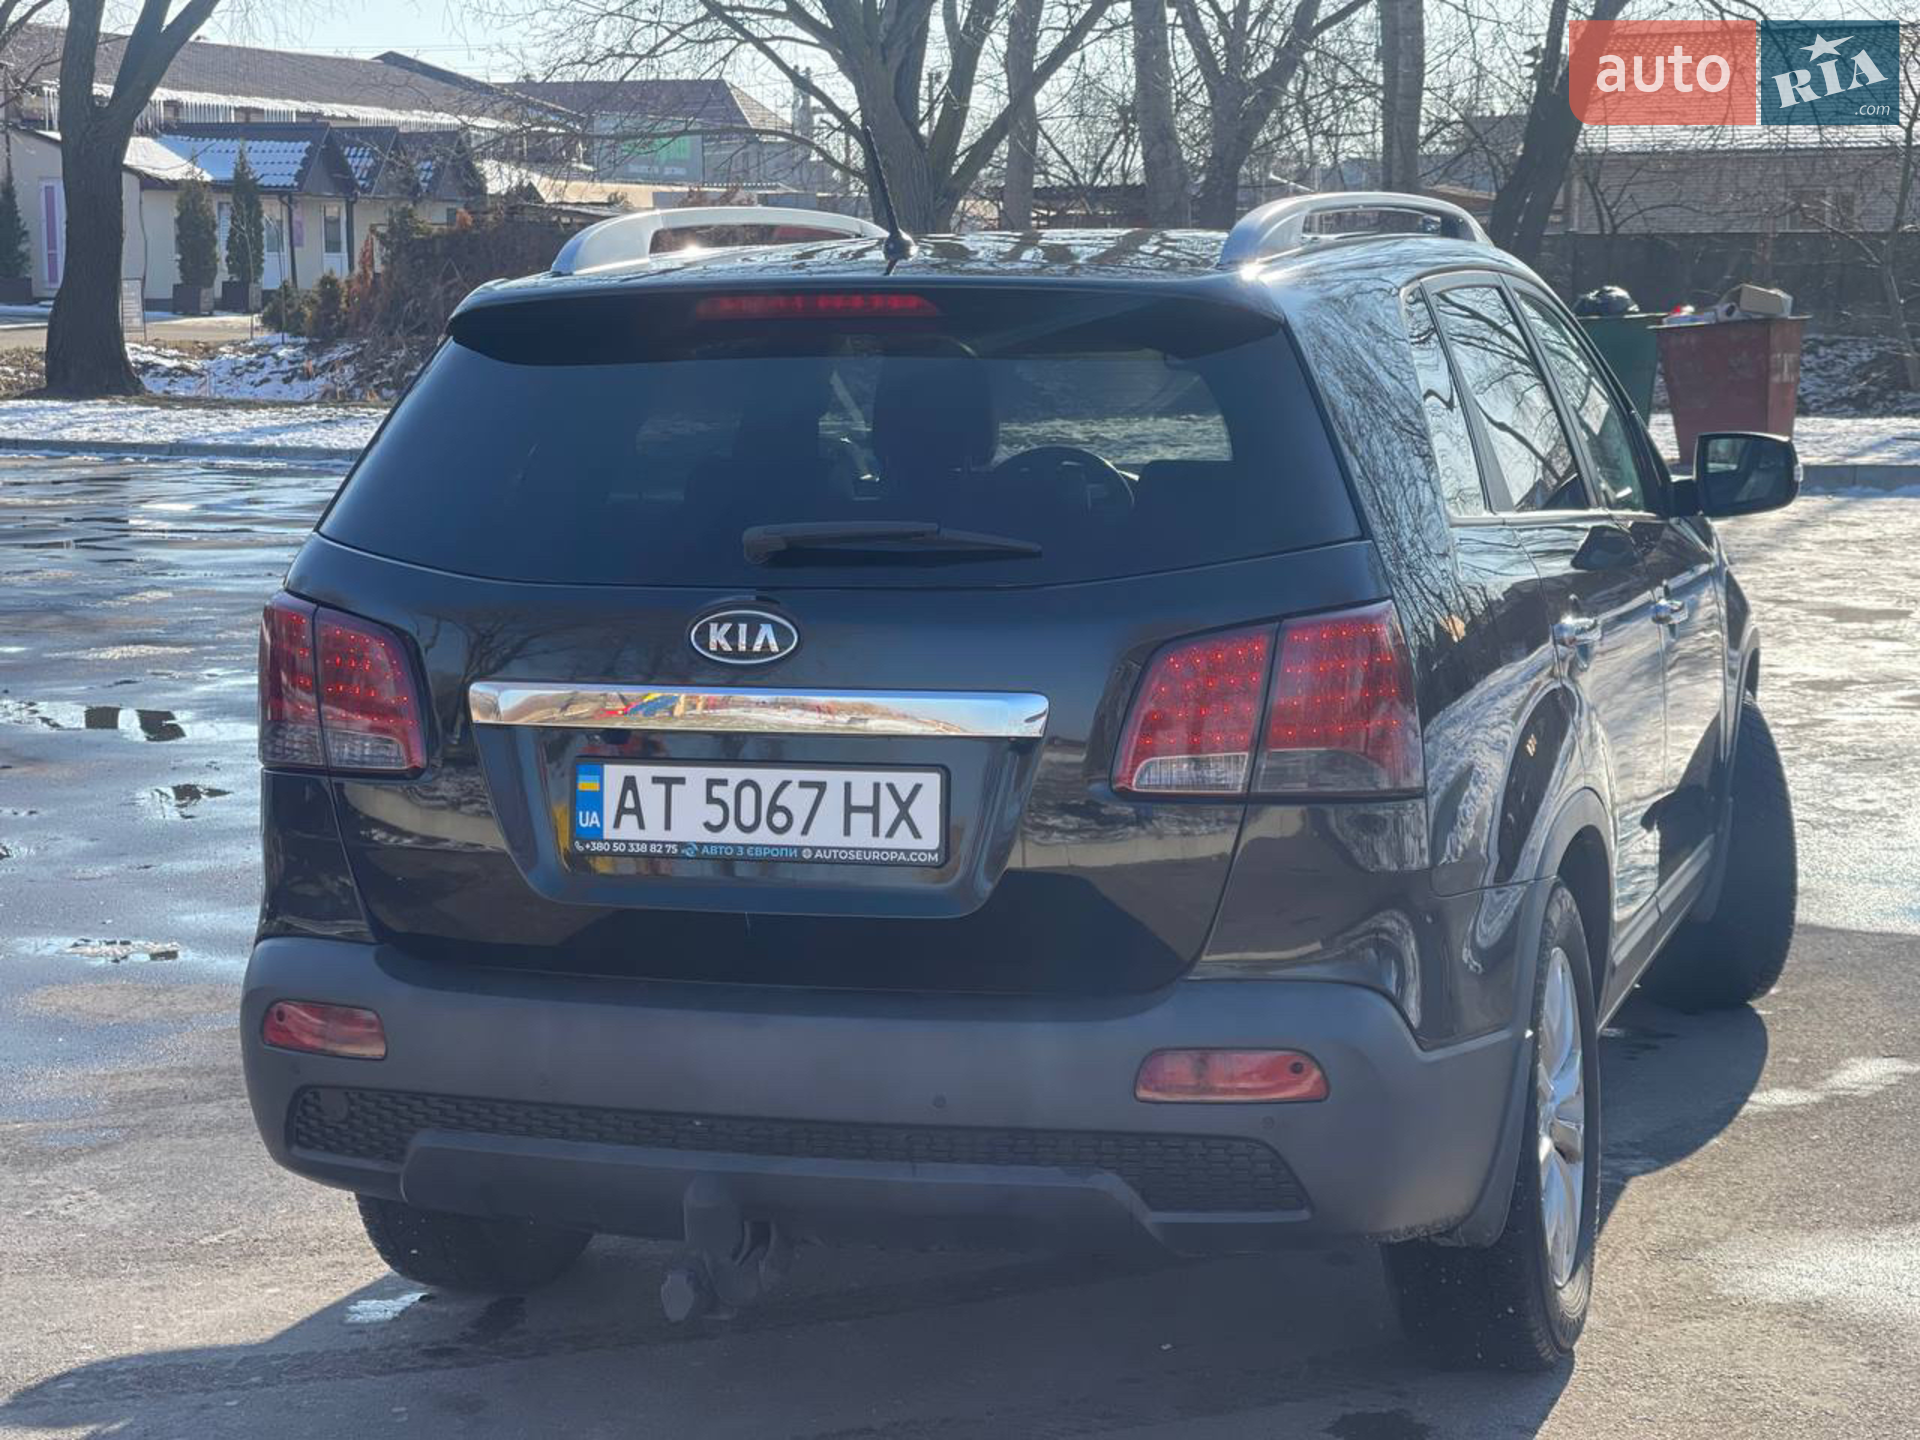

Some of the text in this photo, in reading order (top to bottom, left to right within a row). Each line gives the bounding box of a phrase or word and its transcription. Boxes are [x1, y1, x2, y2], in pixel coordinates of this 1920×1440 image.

[708, 622, 779, 652] KIA
[613, 775, 923, 840] AT 5067 HX
[578, 810, 601, 828] UA
[585, 841, 678, 855] +380 50 338 82 75
[702, 845, 734, 857] АВТО
[814, 849, 939, 863] AUTOSEUROPA.COM
